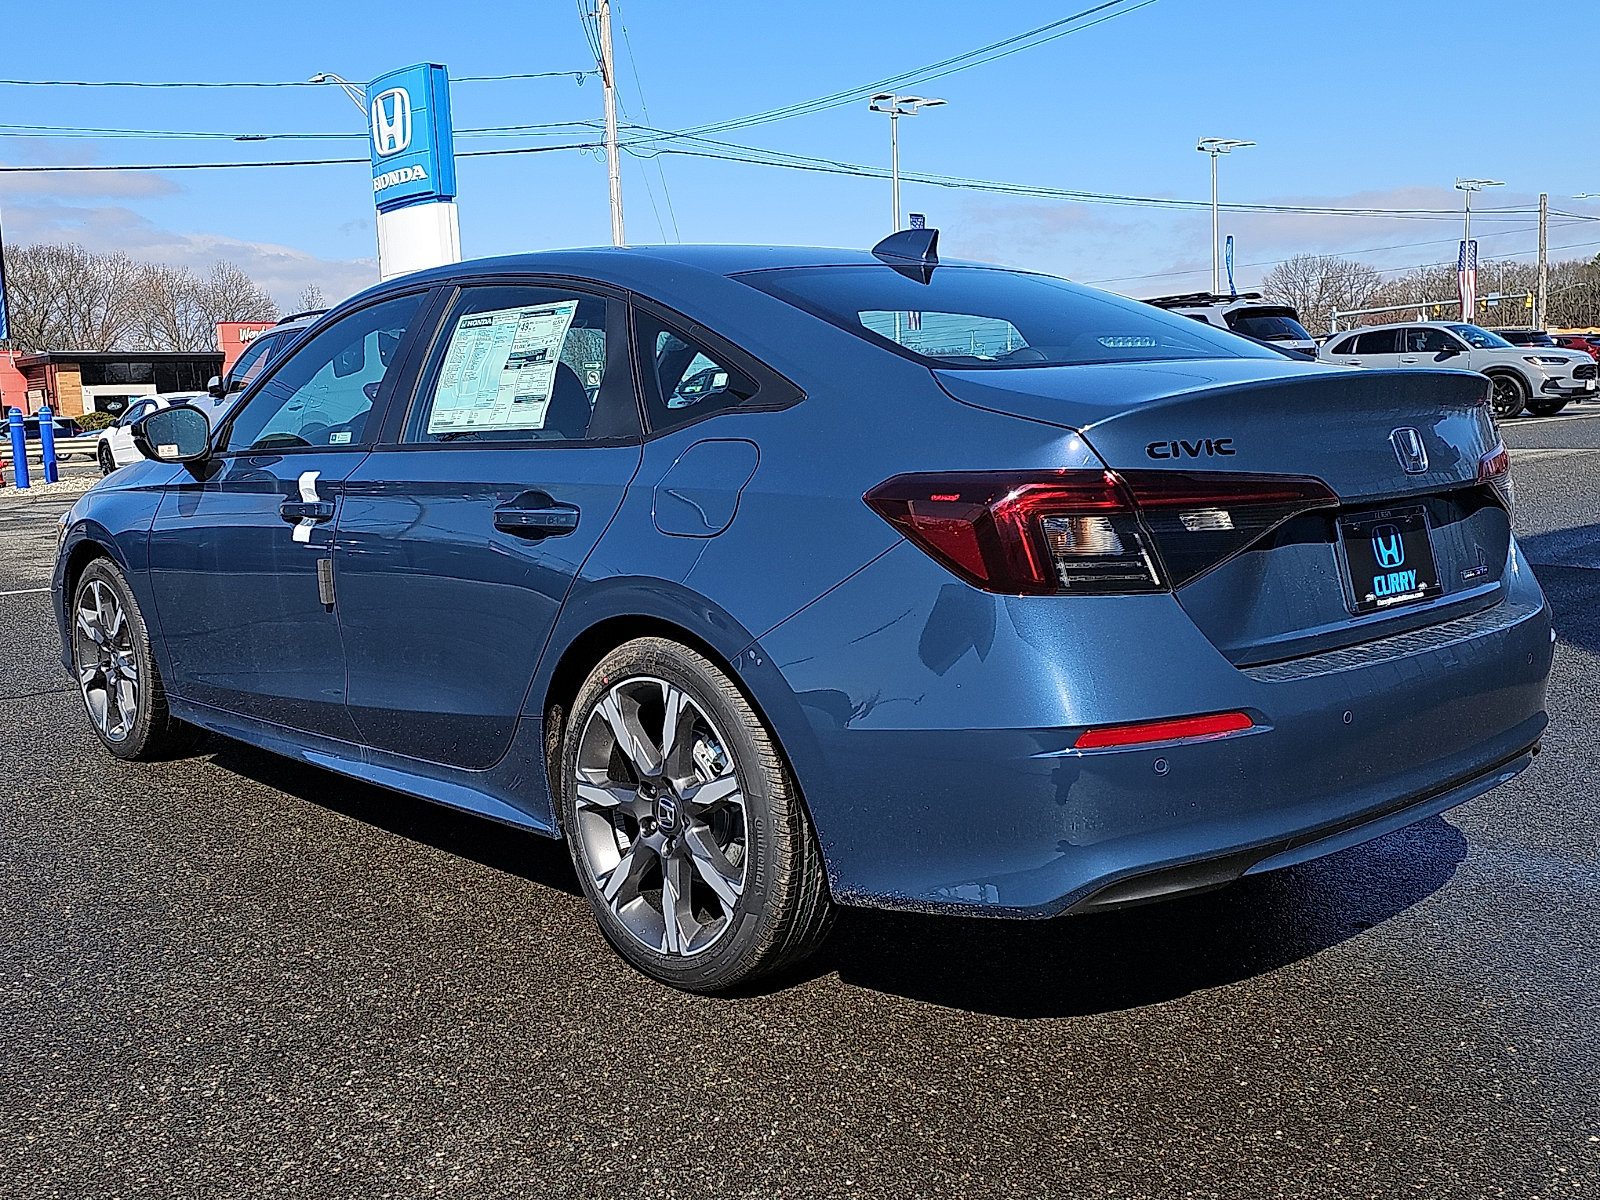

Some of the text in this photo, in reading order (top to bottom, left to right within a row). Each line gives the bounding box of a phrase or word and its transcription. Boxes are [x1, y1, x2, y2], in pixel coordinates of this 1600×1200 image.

[373, 164, 428, 191] HONDA
[467, 317, 492, 327] HONDA
[1145, 438, 1236, 459] CIVIC
[1373, 569, 1416, 597] CURRY
[754, 816, 765, 888] Continental
